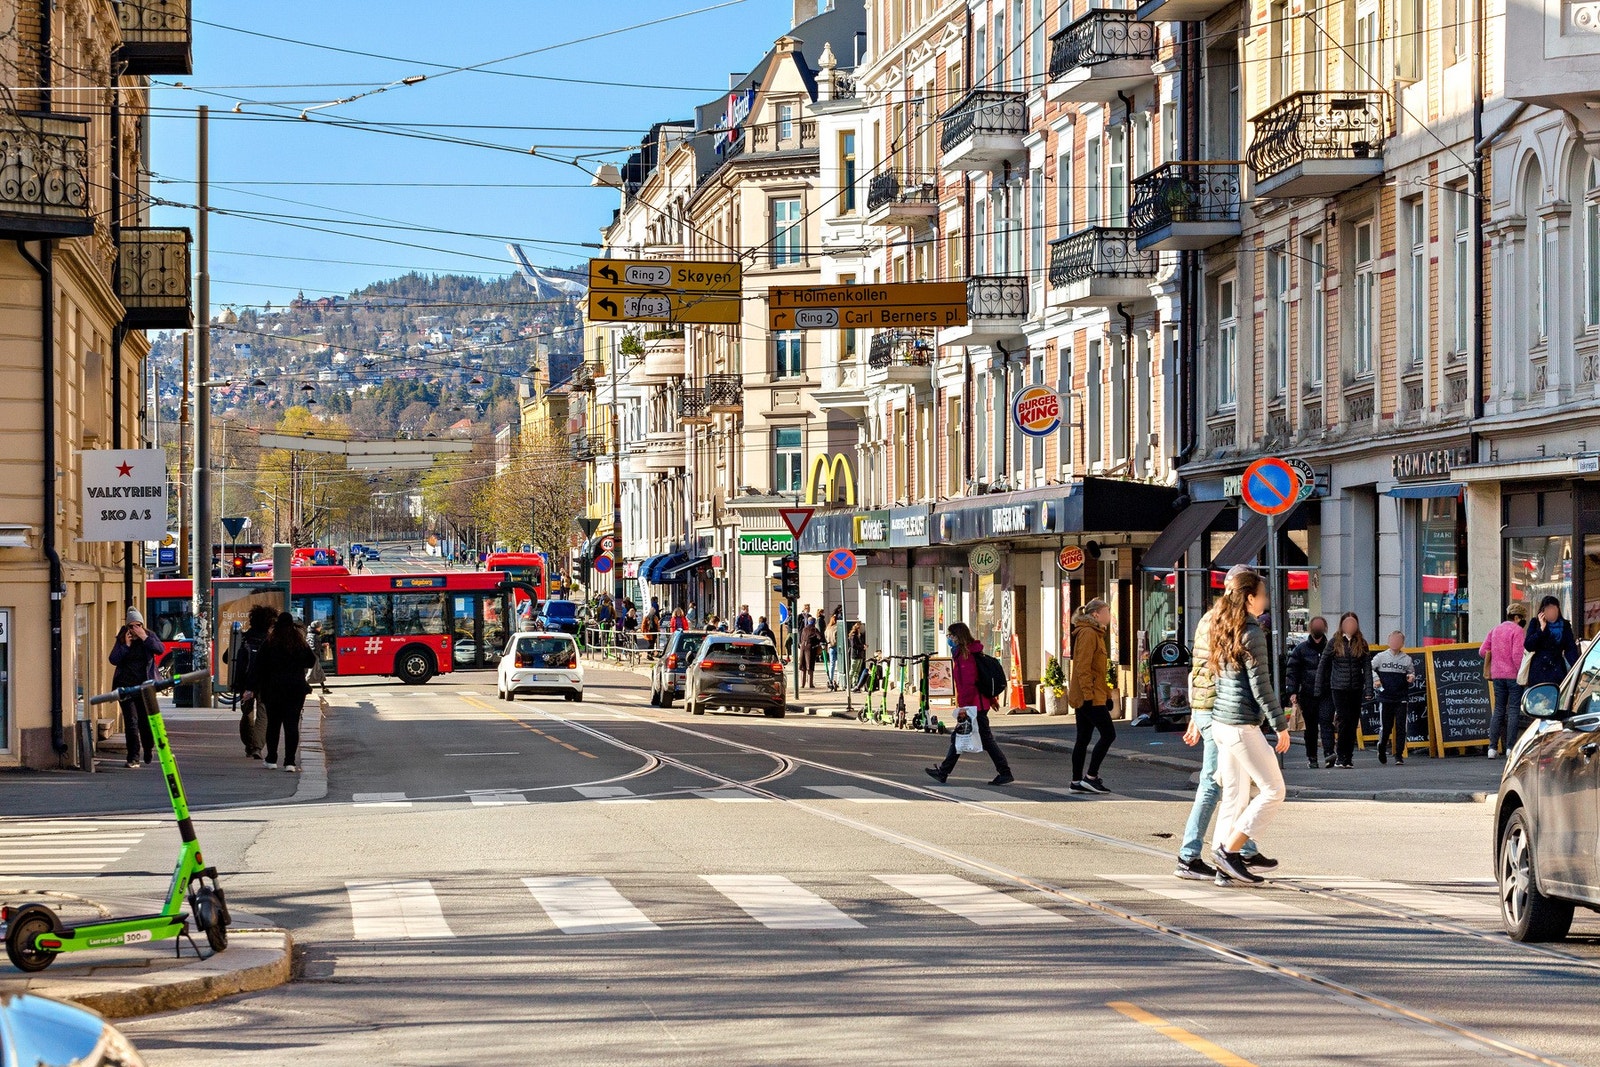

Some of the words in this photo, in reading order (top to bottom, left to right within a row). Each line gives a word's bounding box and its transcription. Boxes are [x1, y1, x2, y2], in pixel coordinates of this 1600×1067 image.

[632, 270, 654, 282] Ring
[658, 270, 664, 280] 2
[678, 270, 732, 286] Skøyen
[793, 288, 888, 303] Holmenkollen
[631, 302, 654, 313] Rng
[657, 302, 664, 312] 3
[800, 312, 823, 324] Ring
[826, 312, 834, 323] 2
[845, 310, 873, 324] Carl
[881, 310, 938, 323] Berners
[946, 311, 962, 324] pl.
[1018, 395, 1056, 413] BURGER
[1020, 404, 1058, 426] KING
[1288, 459, 1312, 478] RESSO
[86, 486, 162, 498] VALKYRIEN
[100, 510, 127, 521] SKO
[130, 509, 152, 520] A/S
[740, 538, 793, 551] brilleland
[976, 554, 994, 566] life
[1060, 550, 1082, 560] BURGER
[1062, 555, 1083, 566] KING
[1382, 662, 1408, 670] adidas
[127, 933, 141, 942] 300
